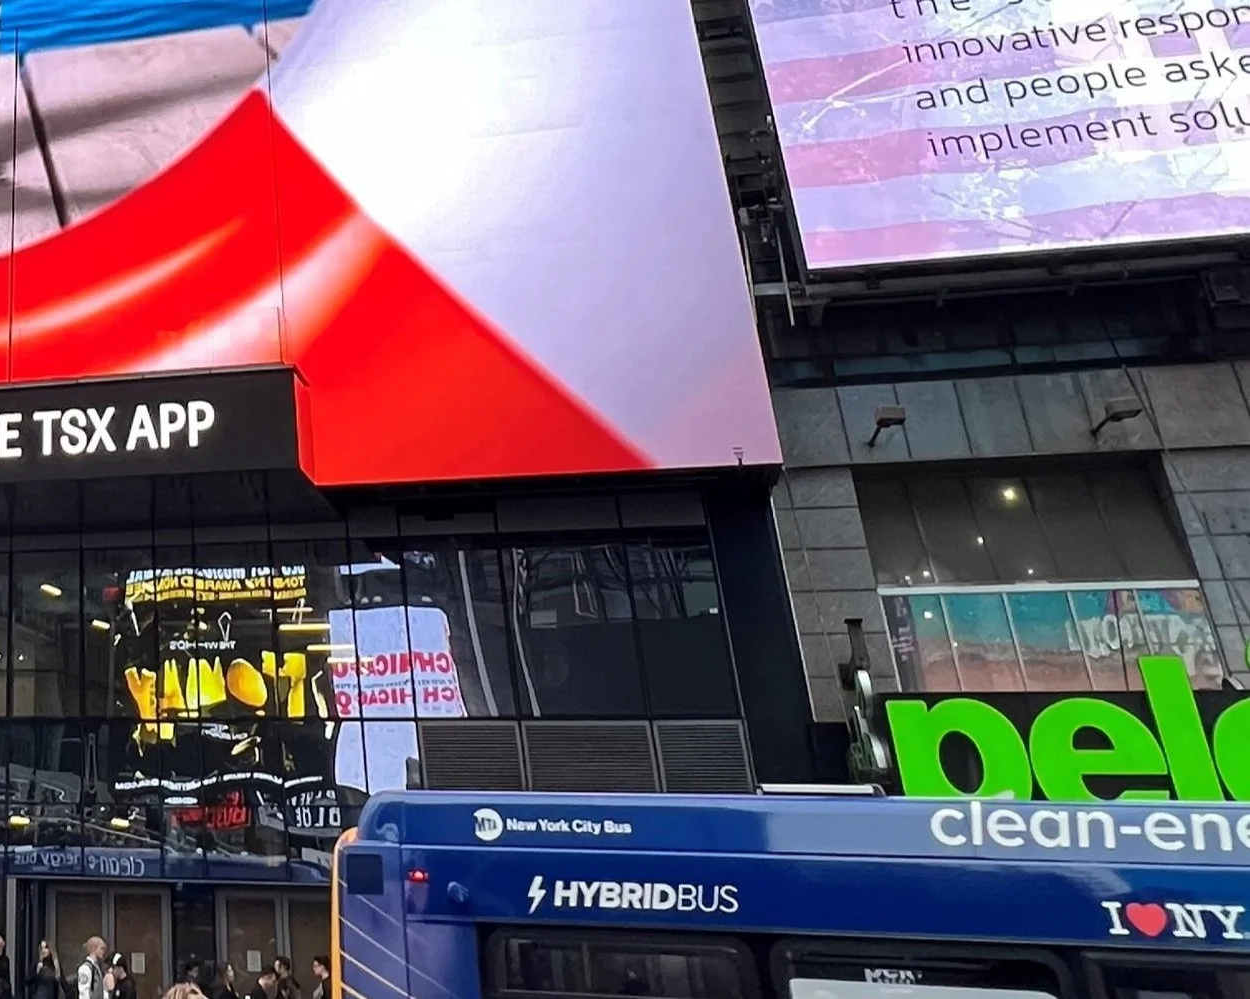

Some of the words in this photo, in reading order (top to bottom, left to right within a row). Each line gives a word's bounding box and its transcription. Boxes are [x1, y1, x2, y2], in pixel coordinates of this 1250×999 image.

[901, 18, 1110, 65] innovative
[916, 78, 990, 111] and
[1004, 62, 1148, 108] people
[926, 108, 1158, 159] implement
[32, 406, 116, 456] TSX
[126, 400, 215, 450] APP
[507, 818, 536, 832] New
[539, 819, 569, 833] York
[572, 820, 601, 836] City
[604, 820, 632, 834] Bus
[553, 880, 739, 913] HYBRIDBUS
